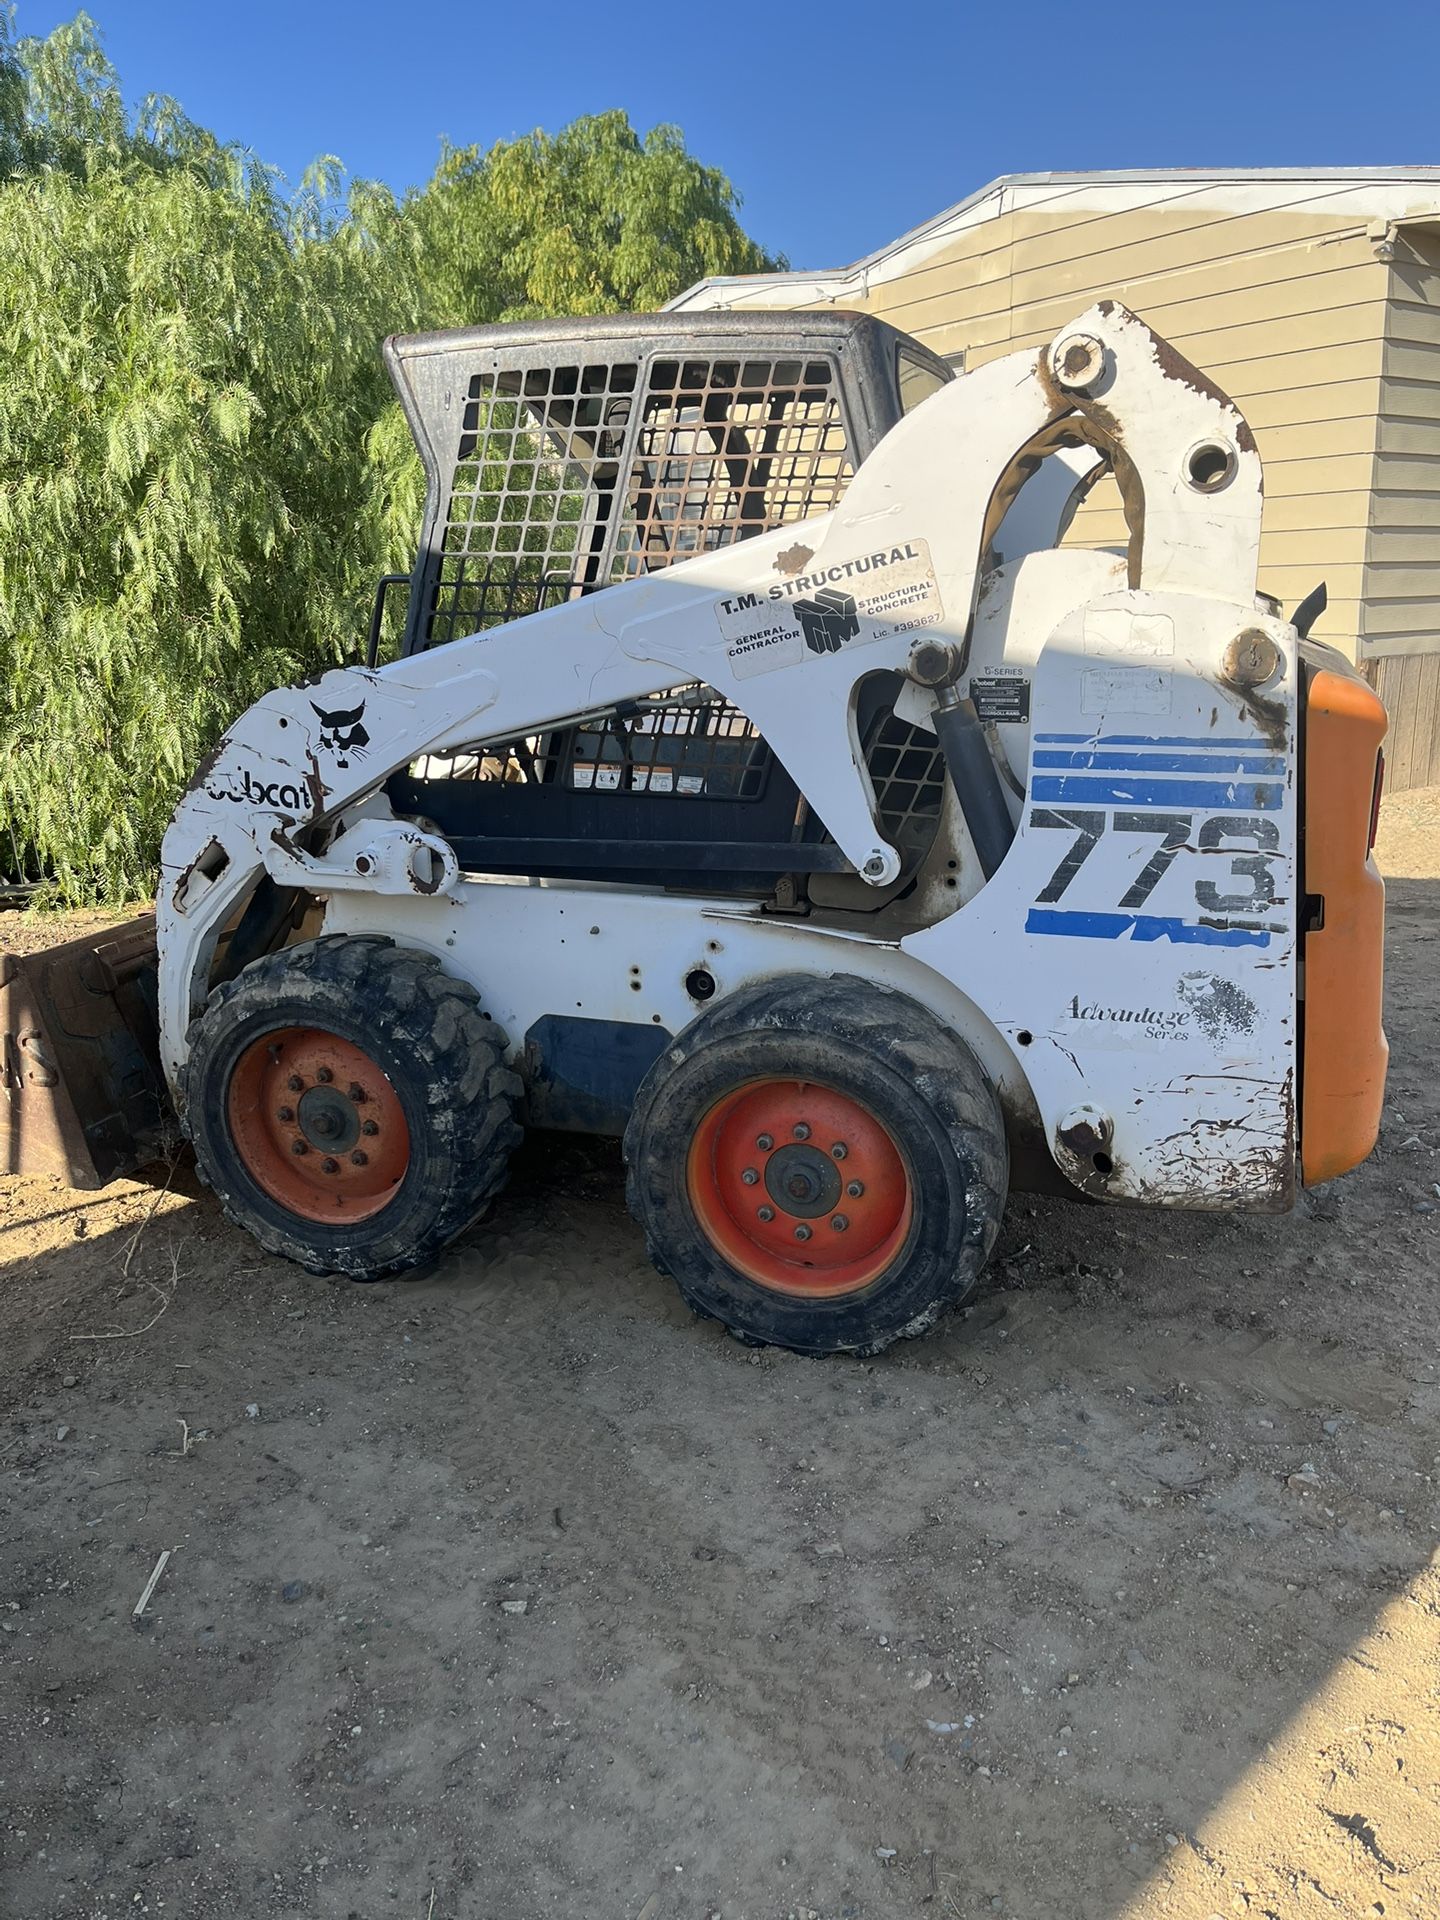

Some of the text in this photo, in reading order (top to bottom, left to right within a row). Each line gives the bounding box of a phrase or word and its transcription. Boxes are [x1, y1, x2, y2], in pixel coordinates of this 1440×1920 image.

[721, 545, 919, 615] T.M. STRUCTURAL
[858, 581, 933, 608] STRUCTURAL
[867, 592, 929, 615] CONCRETE
[735, 626, 786, 646] GENERAL
[873, 613, 941, 640] Lic. #393627
[728, 630, 801, 657] CONTRACTOR
[1030, 808, 1280, 913] 773
